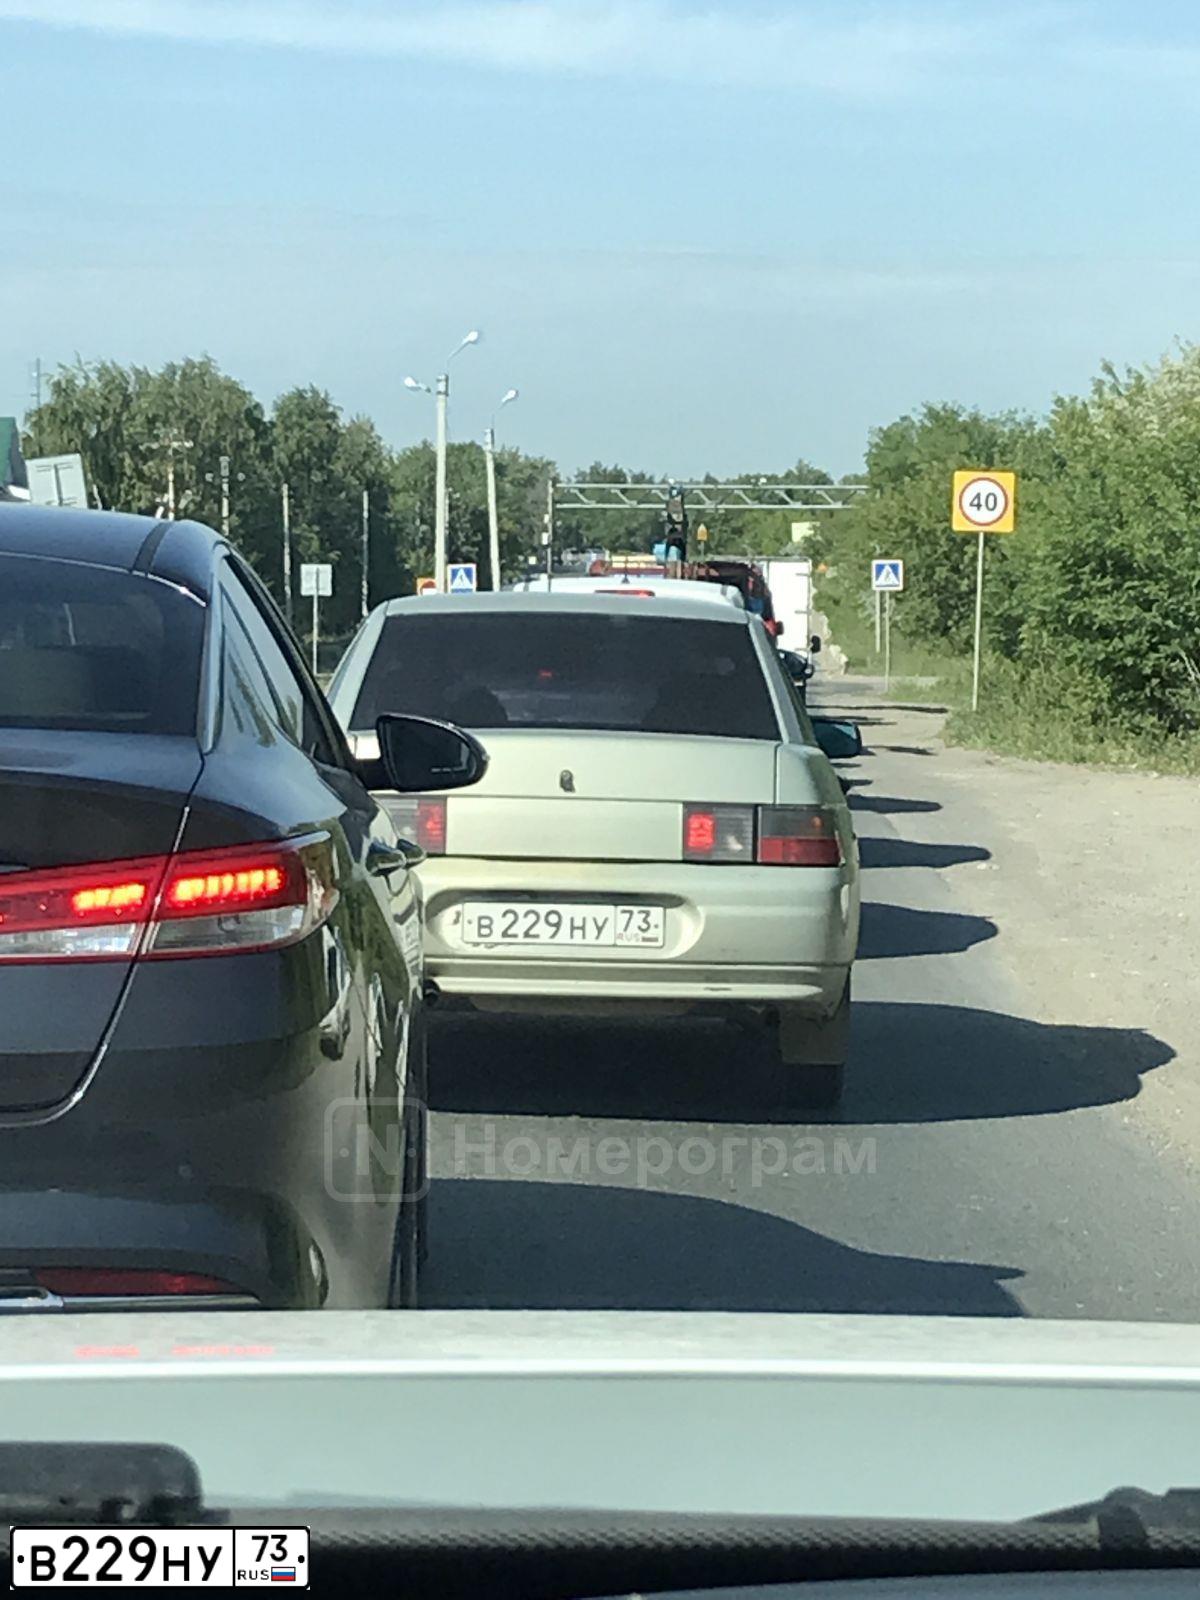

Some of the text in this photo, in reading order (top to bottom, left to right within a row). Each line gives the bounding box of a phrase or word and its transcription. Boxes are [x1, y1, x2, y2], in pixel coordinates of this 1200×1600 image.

[969, 492, 998, 511] 40
[477, 908, 651, 940] В229НУ 73
